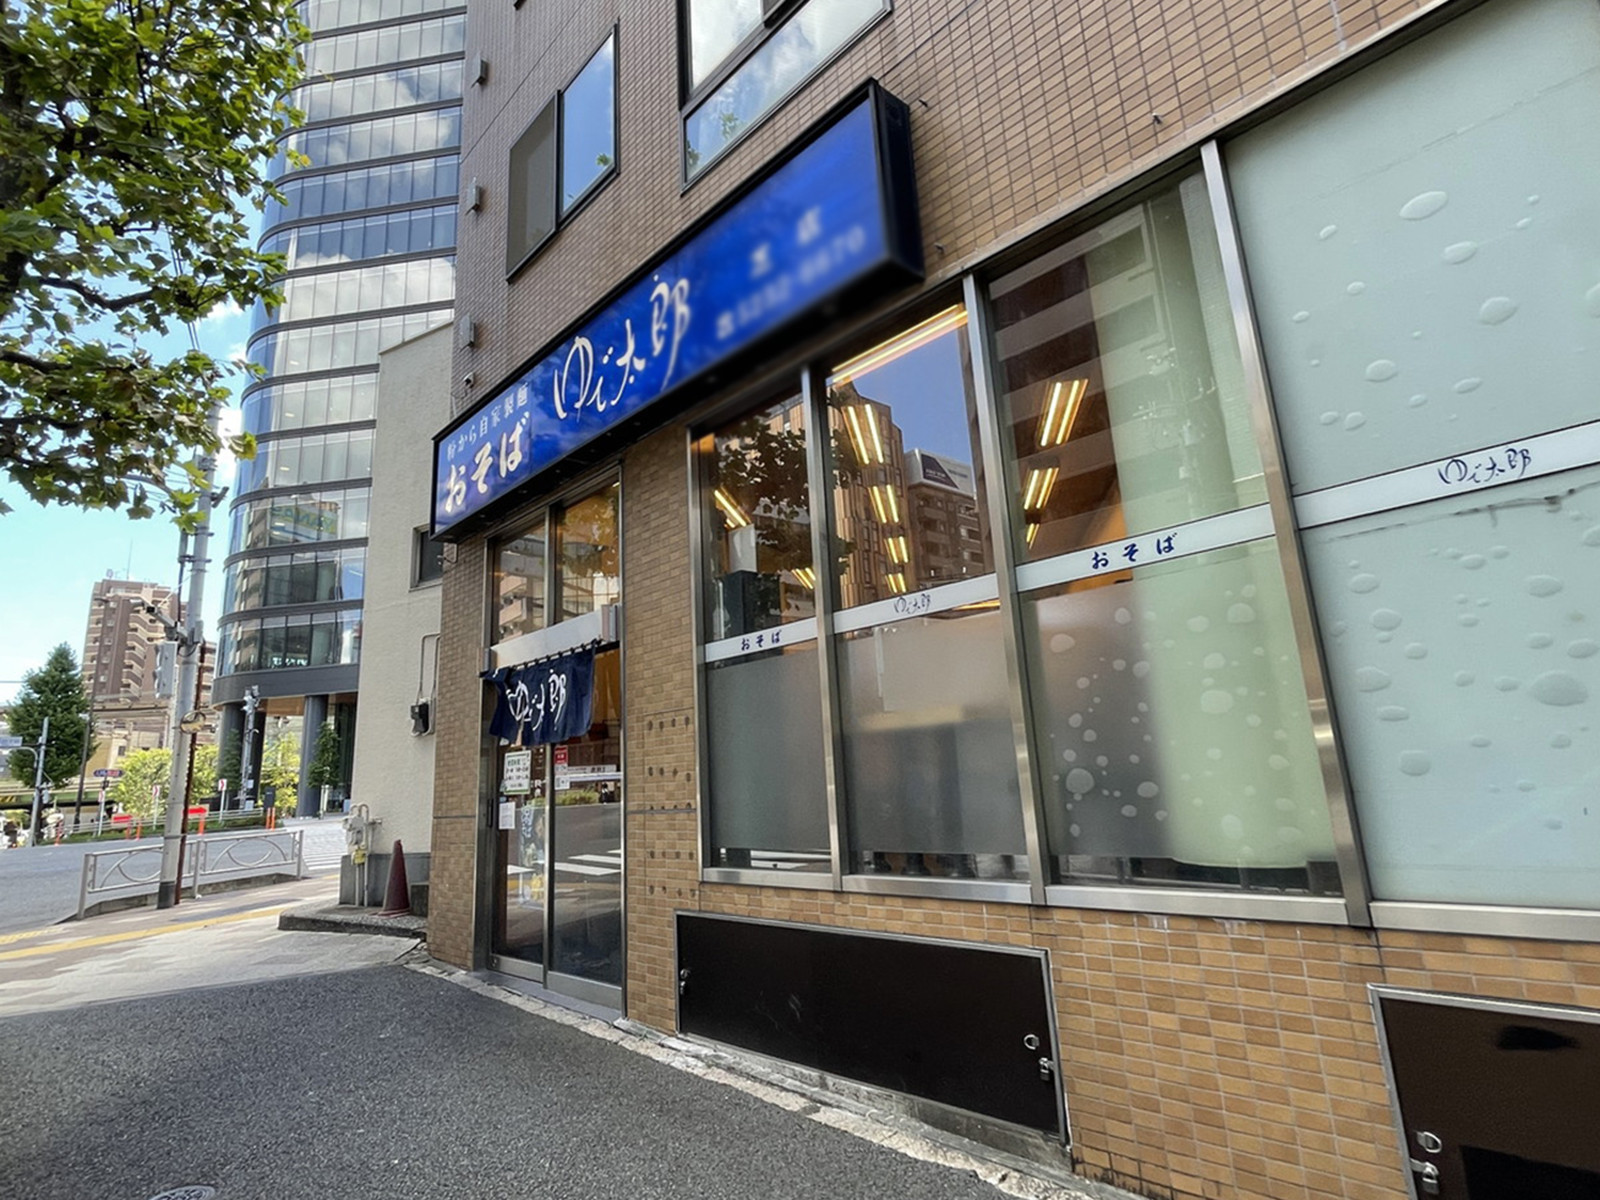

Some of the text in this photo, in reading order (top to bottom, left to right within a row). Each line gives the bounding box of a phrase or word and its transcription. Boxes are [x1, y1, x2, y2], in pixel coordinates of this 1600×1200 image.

[553, 273, 692, 423] ゆで太郎
[445, 411, 530, 513] おそば
[1437, 447, 1532, 485] ゆで太郎
[1091, 532, 1178, 570] おそば
[741, 629, 783, 651] おそば
